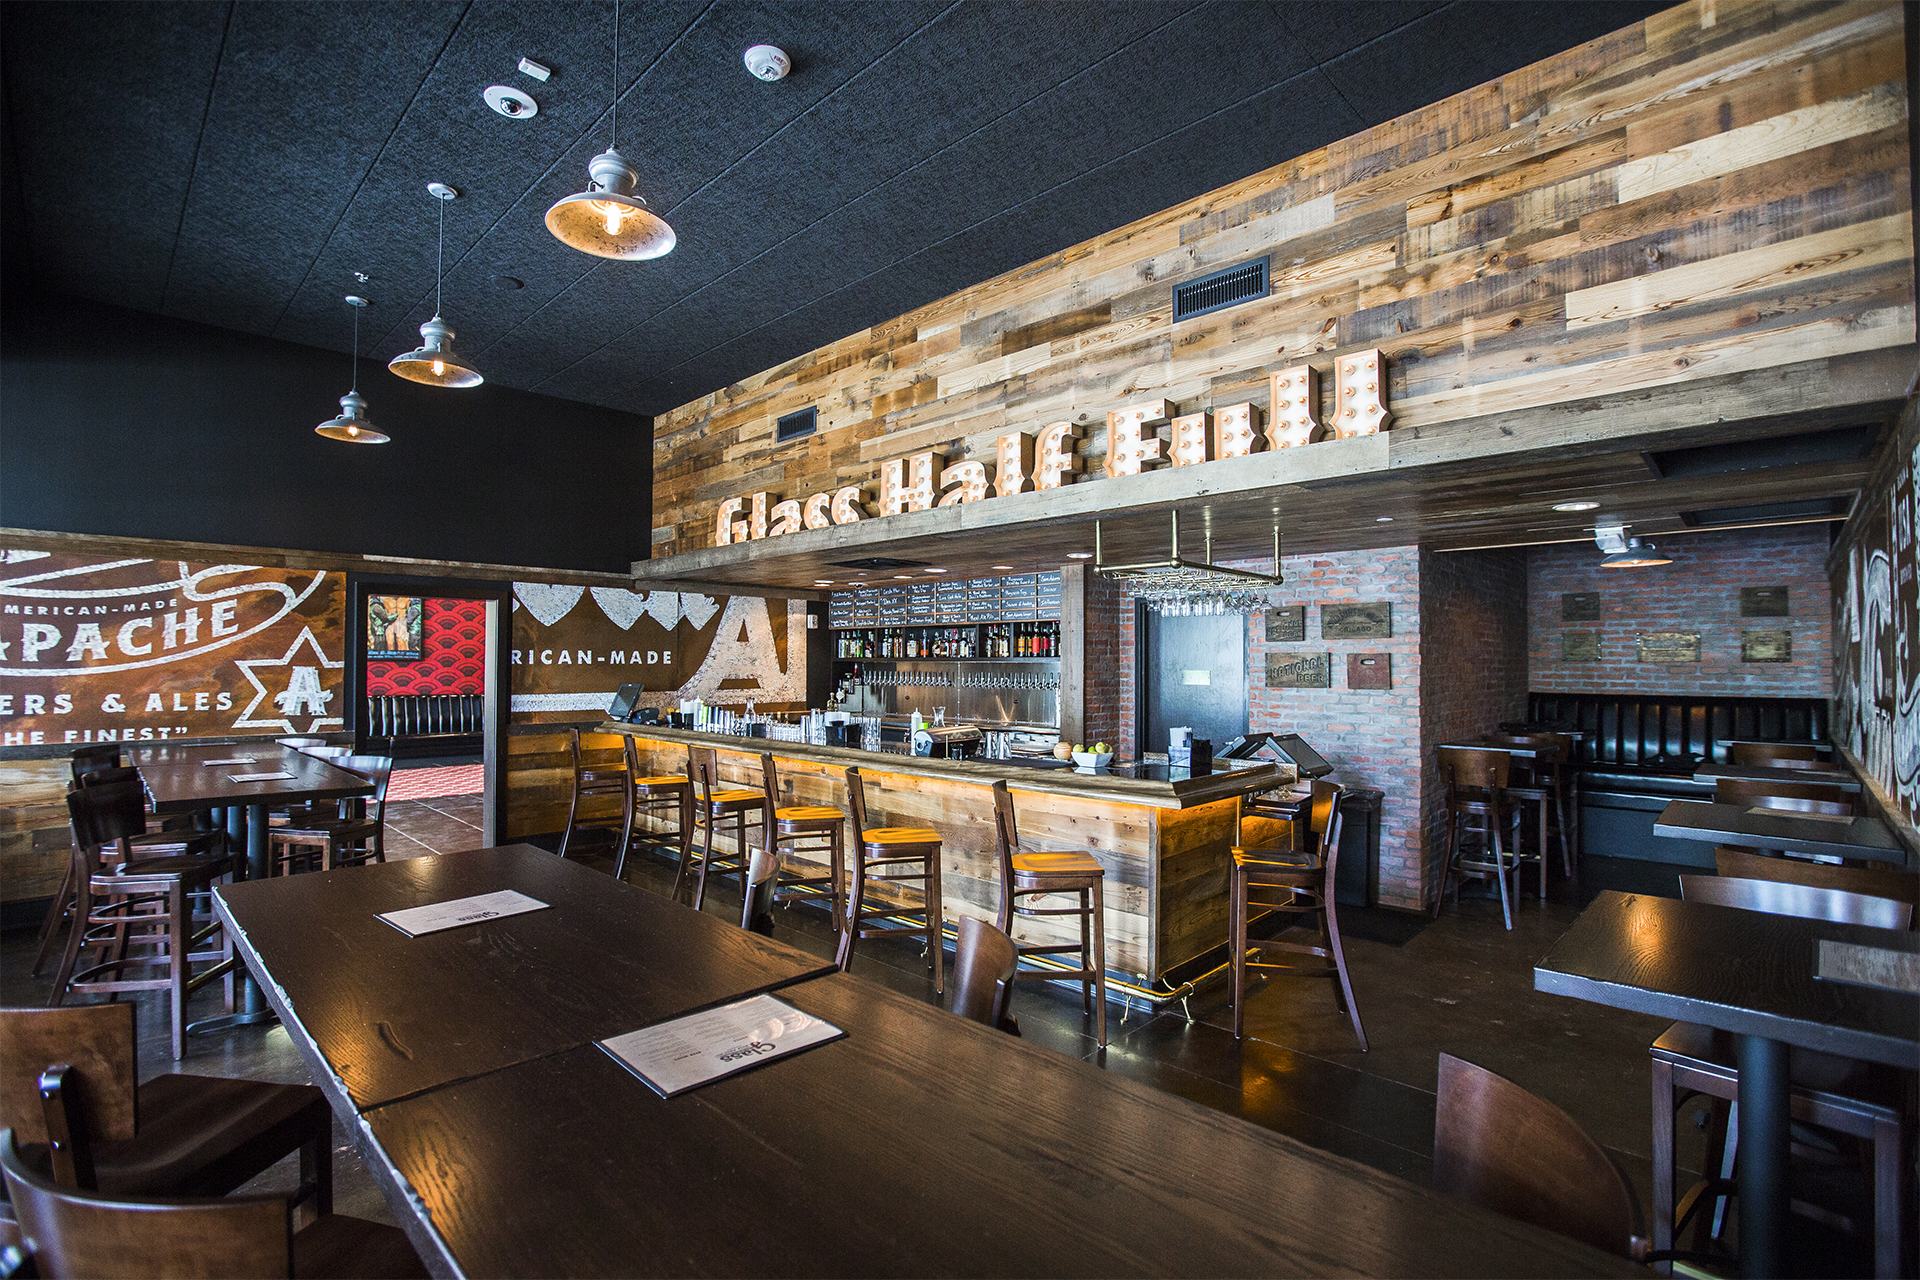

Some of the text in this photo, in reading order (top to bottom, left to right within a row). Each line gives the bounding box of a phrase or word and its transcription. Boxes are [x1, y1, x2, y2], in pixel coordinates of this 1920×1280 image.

[715, 348, 1394, 547] Glass Half Full
[4, 598, 178, 616] MERICAN-MADE
[511, 649, 672, 665] RICAN-MADE
[1266, 656, 1325, 680] NATIONAL
[274, 665, 334, 716] A
[101, 693, 127, 714] &
[145, 691, 233, 713] ALES
[719, 1040, 776, 1063] Glass
